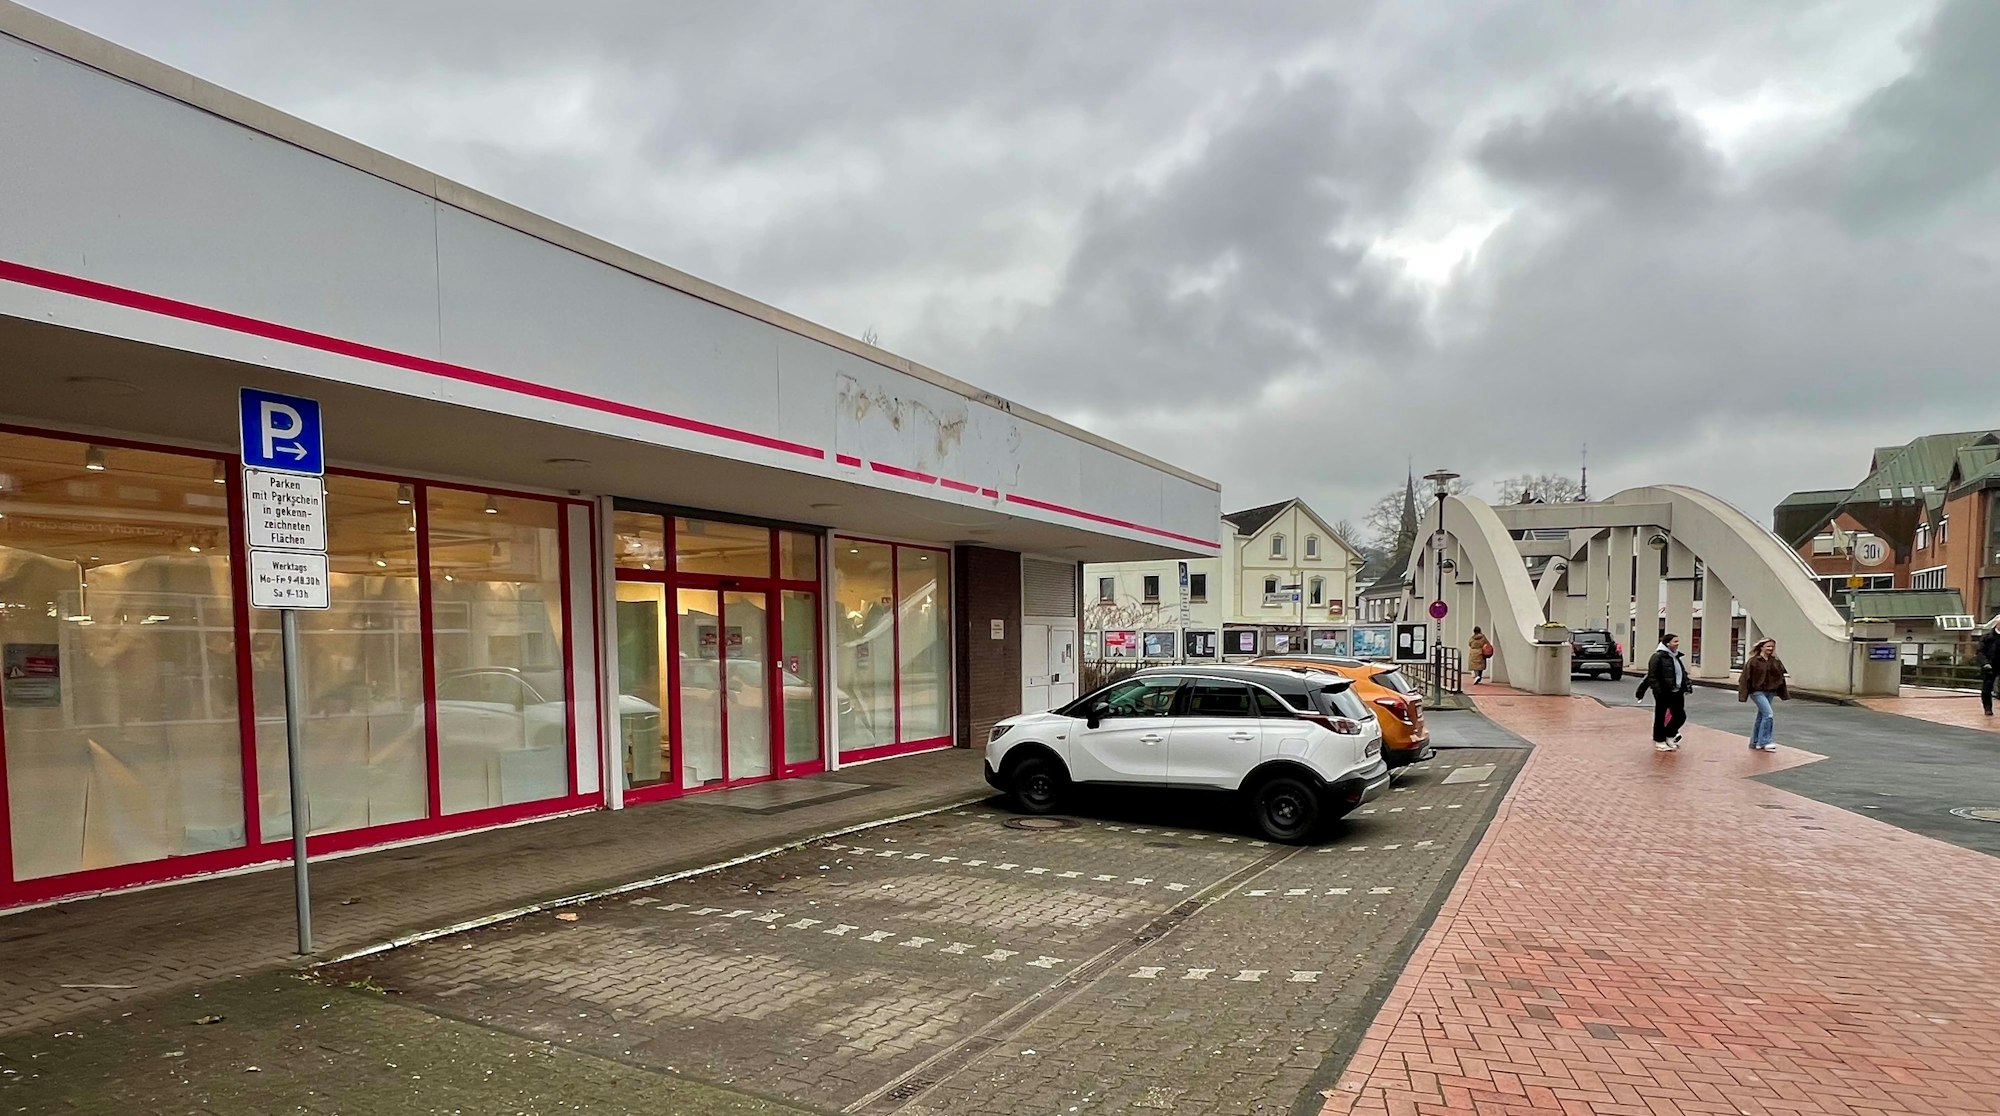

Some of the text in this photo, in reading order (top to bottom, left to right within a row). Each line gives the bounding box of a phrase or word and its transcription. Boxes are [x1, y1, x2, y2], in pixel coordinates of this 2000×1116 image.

[261, 401, 303, 459] P
[270, 477, 300, 490] Parken
[252, 490, 319, 505] mit Parkschein
[263, 504, 312, 518] in gekenn-
[264, 519, 311, 531] zeichneten
[271, 532, 305, 544] Flächen
[272, 561, 308, 573] Werktags
[273, 588, 283, 598] Sa
